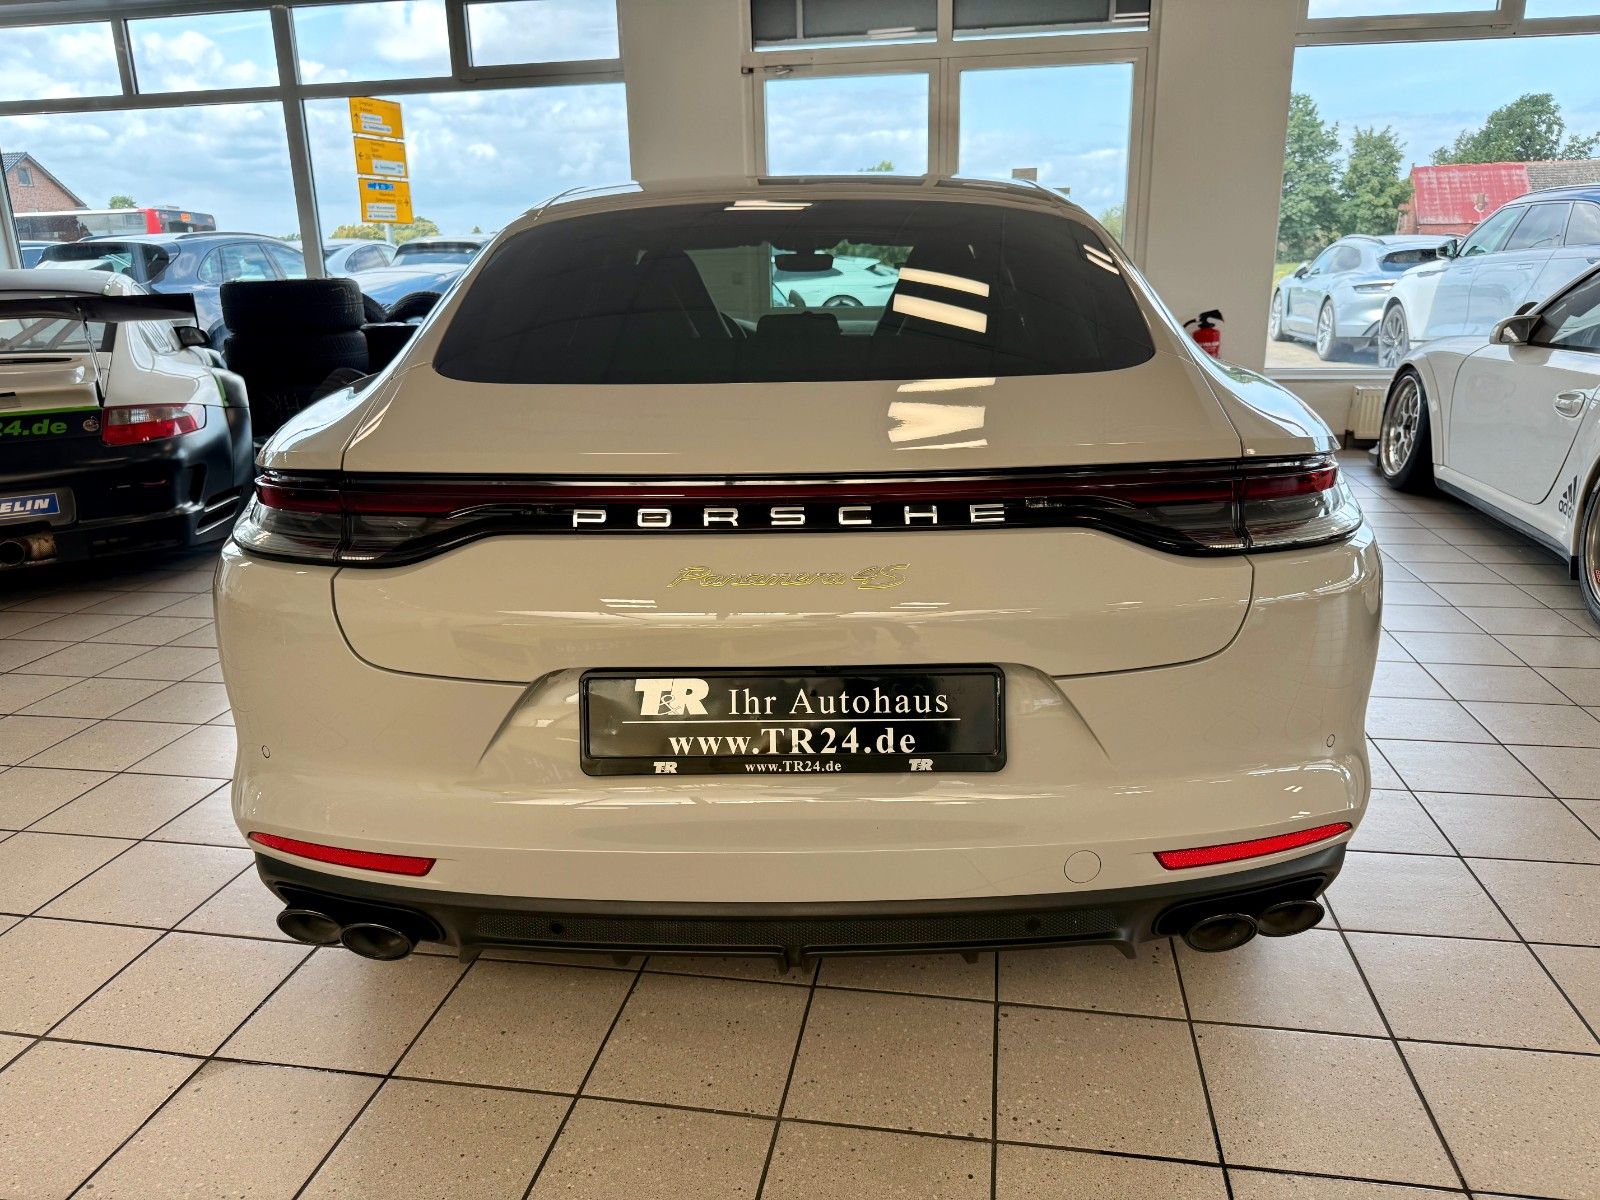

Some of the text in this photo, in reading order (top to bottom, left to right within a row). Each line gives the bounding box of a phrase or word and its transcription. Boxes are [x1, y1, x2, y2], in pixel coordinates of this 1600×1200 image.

[0, 418, 67, 436] 4.de
[572, 504, 1006, 528] PORSCHE
[666, 563, 911, 589] Panamera 4S
[728, 688, 777, 715] Ihr
[789, 686, 949, 714] Autohaus
[668, 726, 916, 756] www.TR24.de
[745, 760, 842, 773] www.TR24.de
